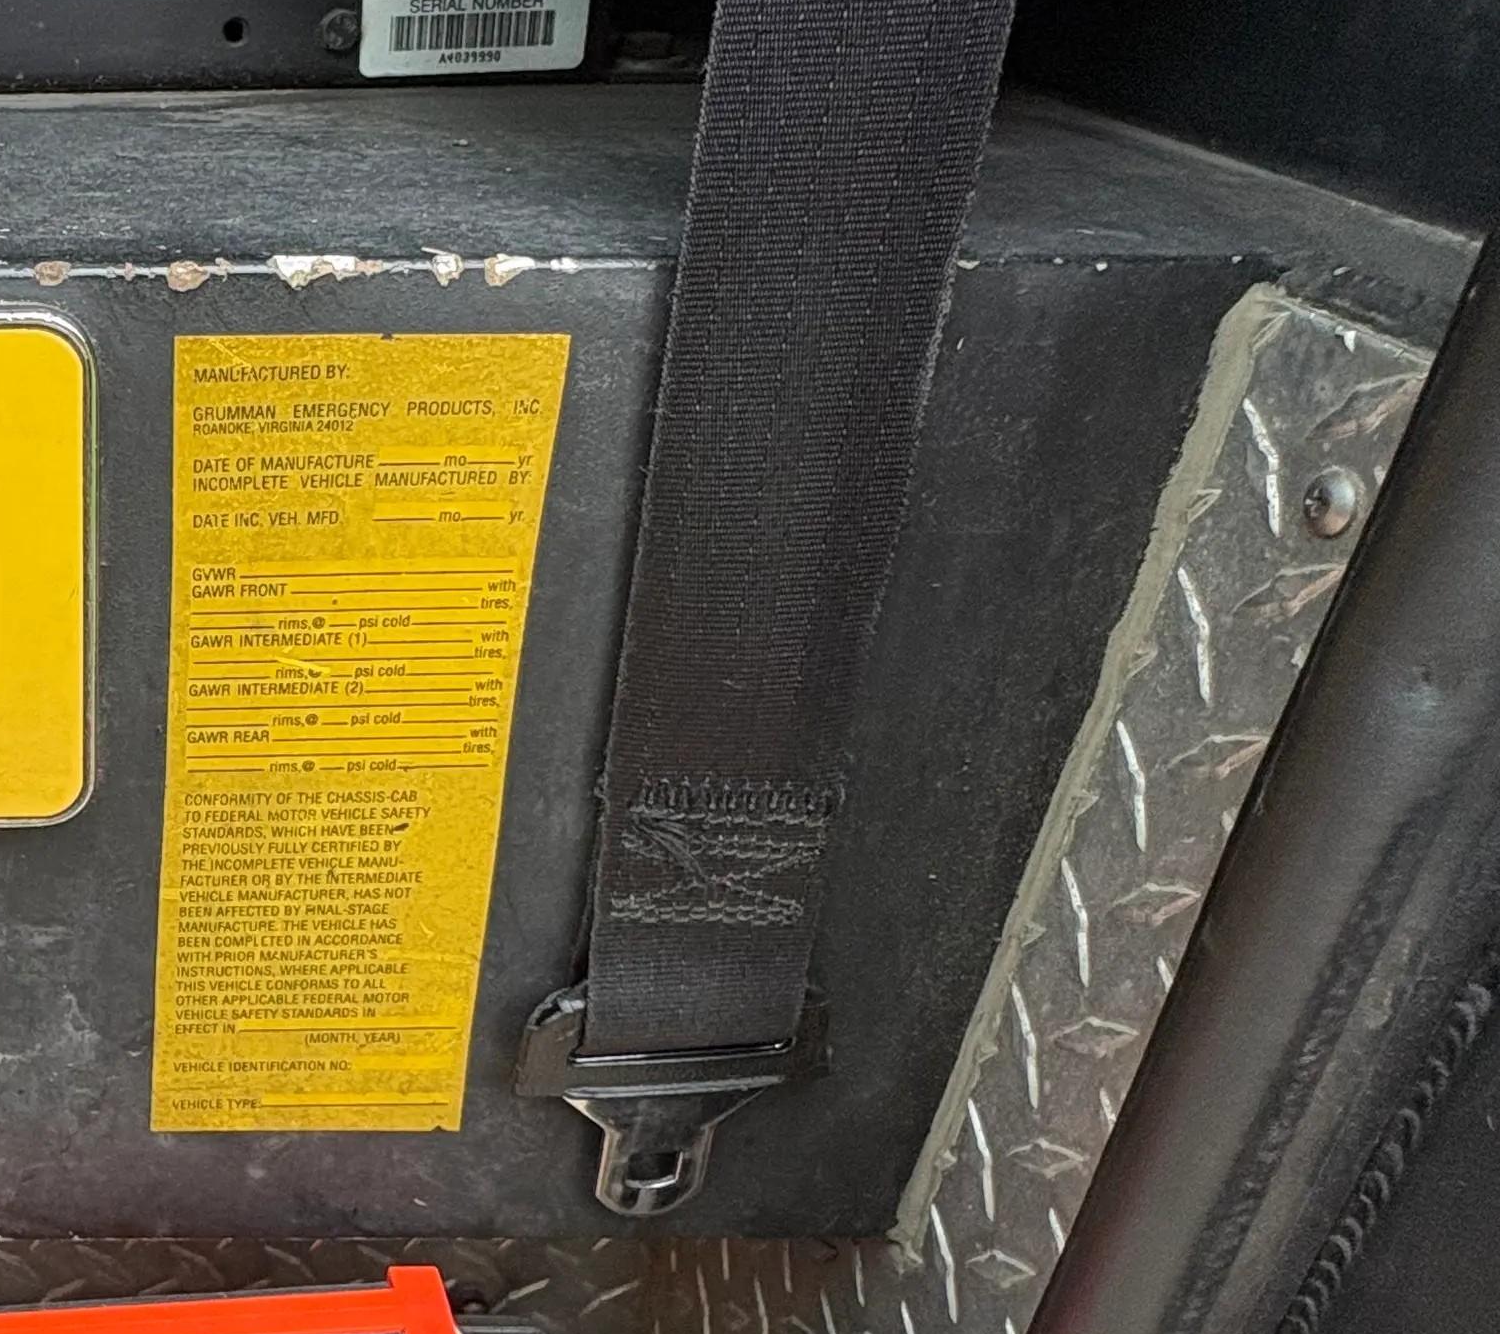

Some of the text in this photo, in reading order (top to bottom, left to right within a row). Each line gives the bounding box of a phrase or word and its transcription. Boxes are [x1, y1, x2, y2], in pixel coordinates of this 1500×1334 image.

[194, 365, 321, 383] MANUFACTURED
[193, 400, 496, 421] GRUMMAN EMERGENCY PRODUCTS,
[259, 420, 353, 433] VIRGINIA 24012
[193, 454, 375, 473] DATE OF MANUFACTURE
[193, 471, 497, 492] INCOMPLETE VEHICLE MANUFACTURED
[193, 514, 229, 528] DATE
[192, 568, 236, 581] GVWR
[192, 579, 516, 598] GAWR FRONT with
[358, 617, 378, 629] psi
[191, 630, 509, 648] GAWR INTERMEDIATE (1) with
[355, 665, 406, 678] psi cold
[189, 679, 503, 697] GAWR INTERMEDIATE (2) with
[351, 712, 401, 725] psi cold
[187, 726, 497, 743] GAWR REAR with
[348, 759, 397, 772] psi cold
[185, 790, 418, 806] CONFORMITY OF THE CHASSIS-CAB
[185, 807, 431, 823] TO FEDERAL MOTOR VEHICLE SAFETY
[183, 824, 394, 839] STANDARDS, WHICH HAVE BEEN
[183, 840, 402, 855] PREVIOUSLY FULLY CERTIFIED BY
[182, 857, 404, 871] THE INCOMPLETE VEHICLE MANU-
[181, 871, 423, 887] FACTURER OR BY THE INTERMEDIATE
[180, 887, 412, 902] VEHICLE MANUFACTURER, HAS NOT
[180, 905, 301, 917] BEEN AFFECTED BY
[284, 918, 397, 931] THE VEHICLE HAS
[178, 934, 404, 947] BEEN IN ACCORDANCE
[177, 951, 255, 963] WITH PRIOR
[177, 965, 328, 978] INSTRUCTIONS, WHERE
[175, 979, 386, 992] THIS VEHICLE CONFORMS TO ALL
[176, 992, 410, 1006] OTHER APPLICABLE FEDERAL MOTOR
[175, 1008, 376, 1020] VEHICLE SAFETY STANDARDS IN
[175, 1023, 236, 1035] EFFECT IN
[364, 1032, 400, 1044] YEAR)
[173, 1060, 325, 1073] VEHICLE IDENTIFICATION
[172, 1099, 223, 1110] VEHICLE
